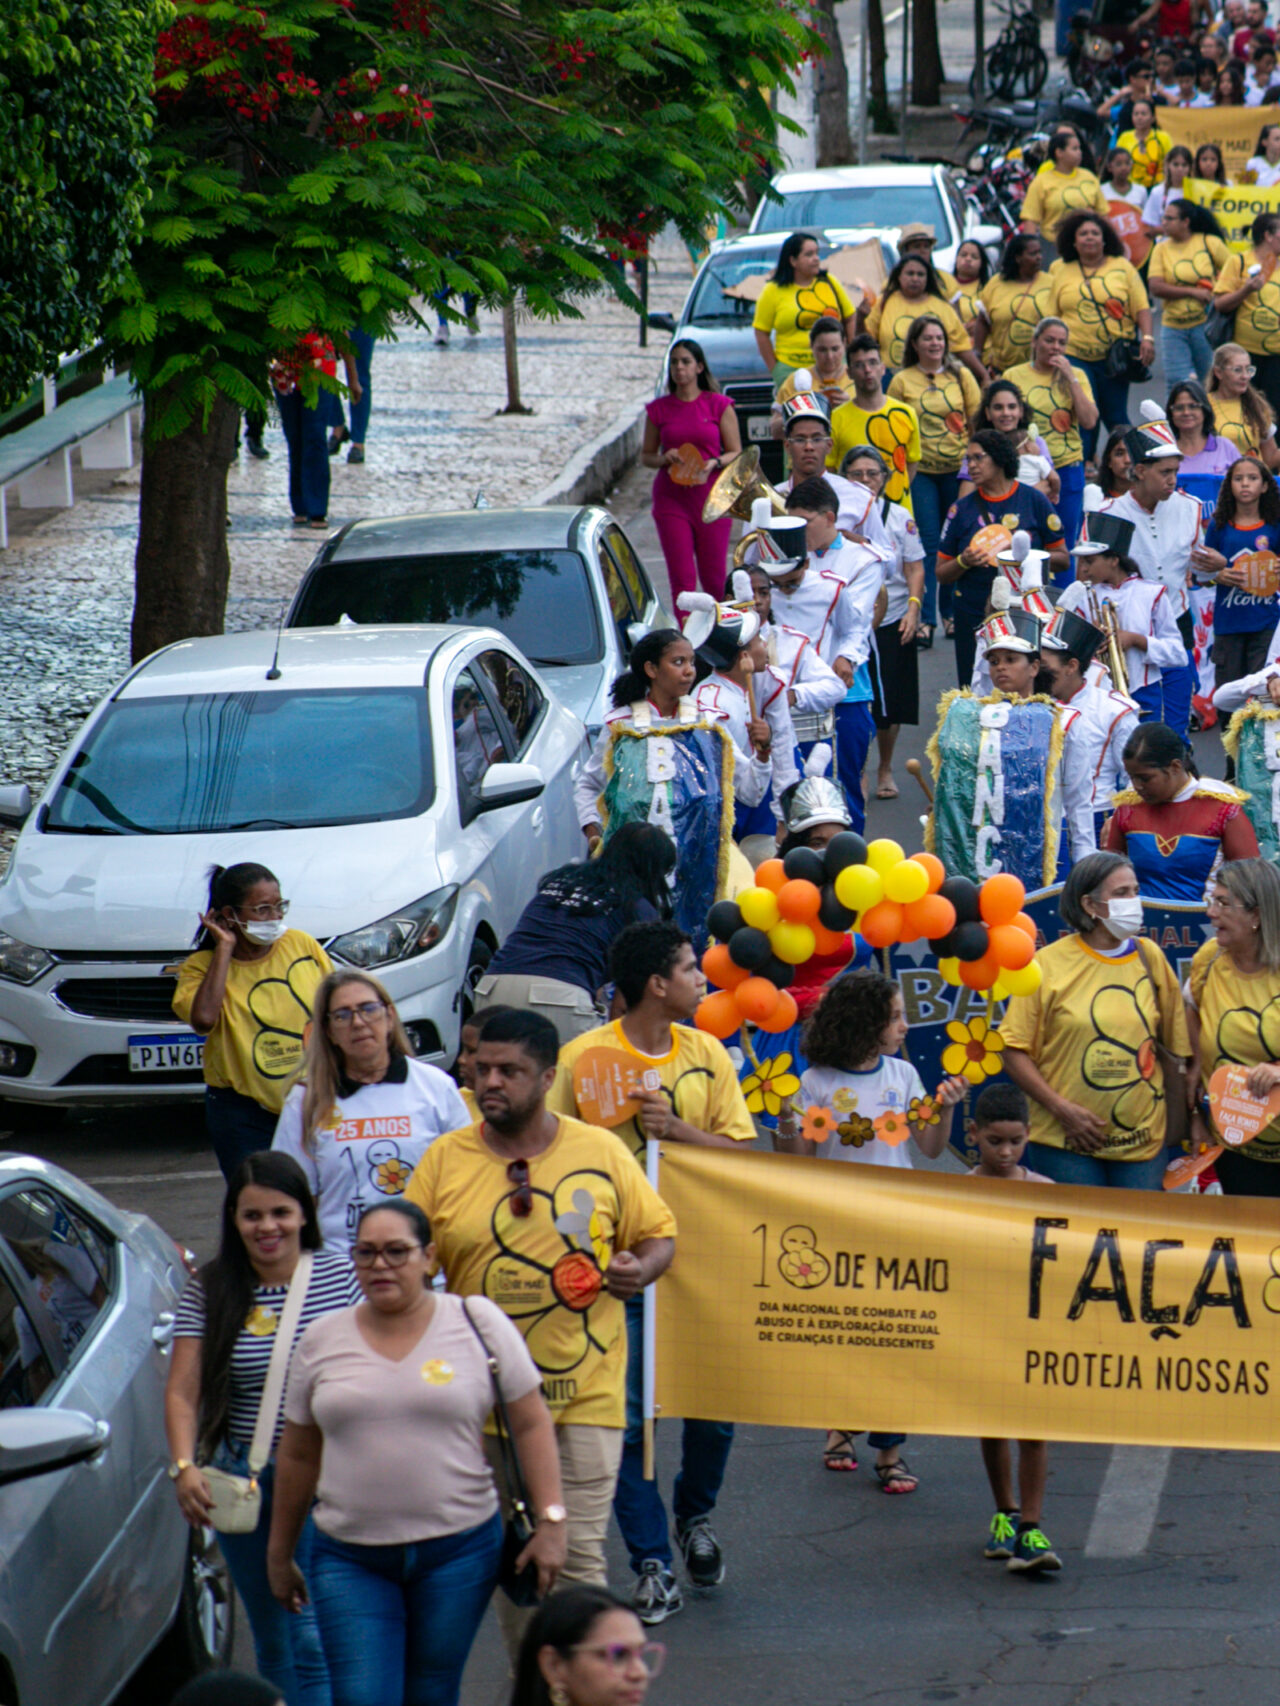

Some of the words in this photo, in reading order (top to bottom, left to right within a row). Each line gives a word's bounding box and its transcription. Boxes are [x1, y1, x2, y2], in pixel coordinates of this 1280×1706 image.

[337, 1120, 358, 1139] 25
[362, 1117, 409, 1137] ANOS
[834, 1251, 866, 1288] DE
[876, 1257, 949, 1292] MAIO
[1028, 1217, 1252, 1340] FAÇA
[759, 1302, 779, 1312] DIA
[782, 1303, 840, 1316] NACIONAL
[844, 1306, 859, 1317] DE
[862, 1307, 917, 1320] COMBATE
[919, 1310, 937, 1320] AO
[755, 1316, 794, 1328] ABUSO
[797, 1319, 803, 1328] E
[807, 1316, 815, 1328] À
[818, 1319, 894, 1335] EXPLORAÇÃO
[897, 1324, 940, 1335] SEXUAL
[758, 1331, 773, 1341] DE
[777, 1332, 834, 1347] CRIANÇAS
[837, 1335, 844, 1345] E
[847, 1336, 935, 1350] ADOLESCENTES
[1025, 1350, 1142, 1389] PROTEJA
[1156, 1357, 1270, 1395] NOSSAS
